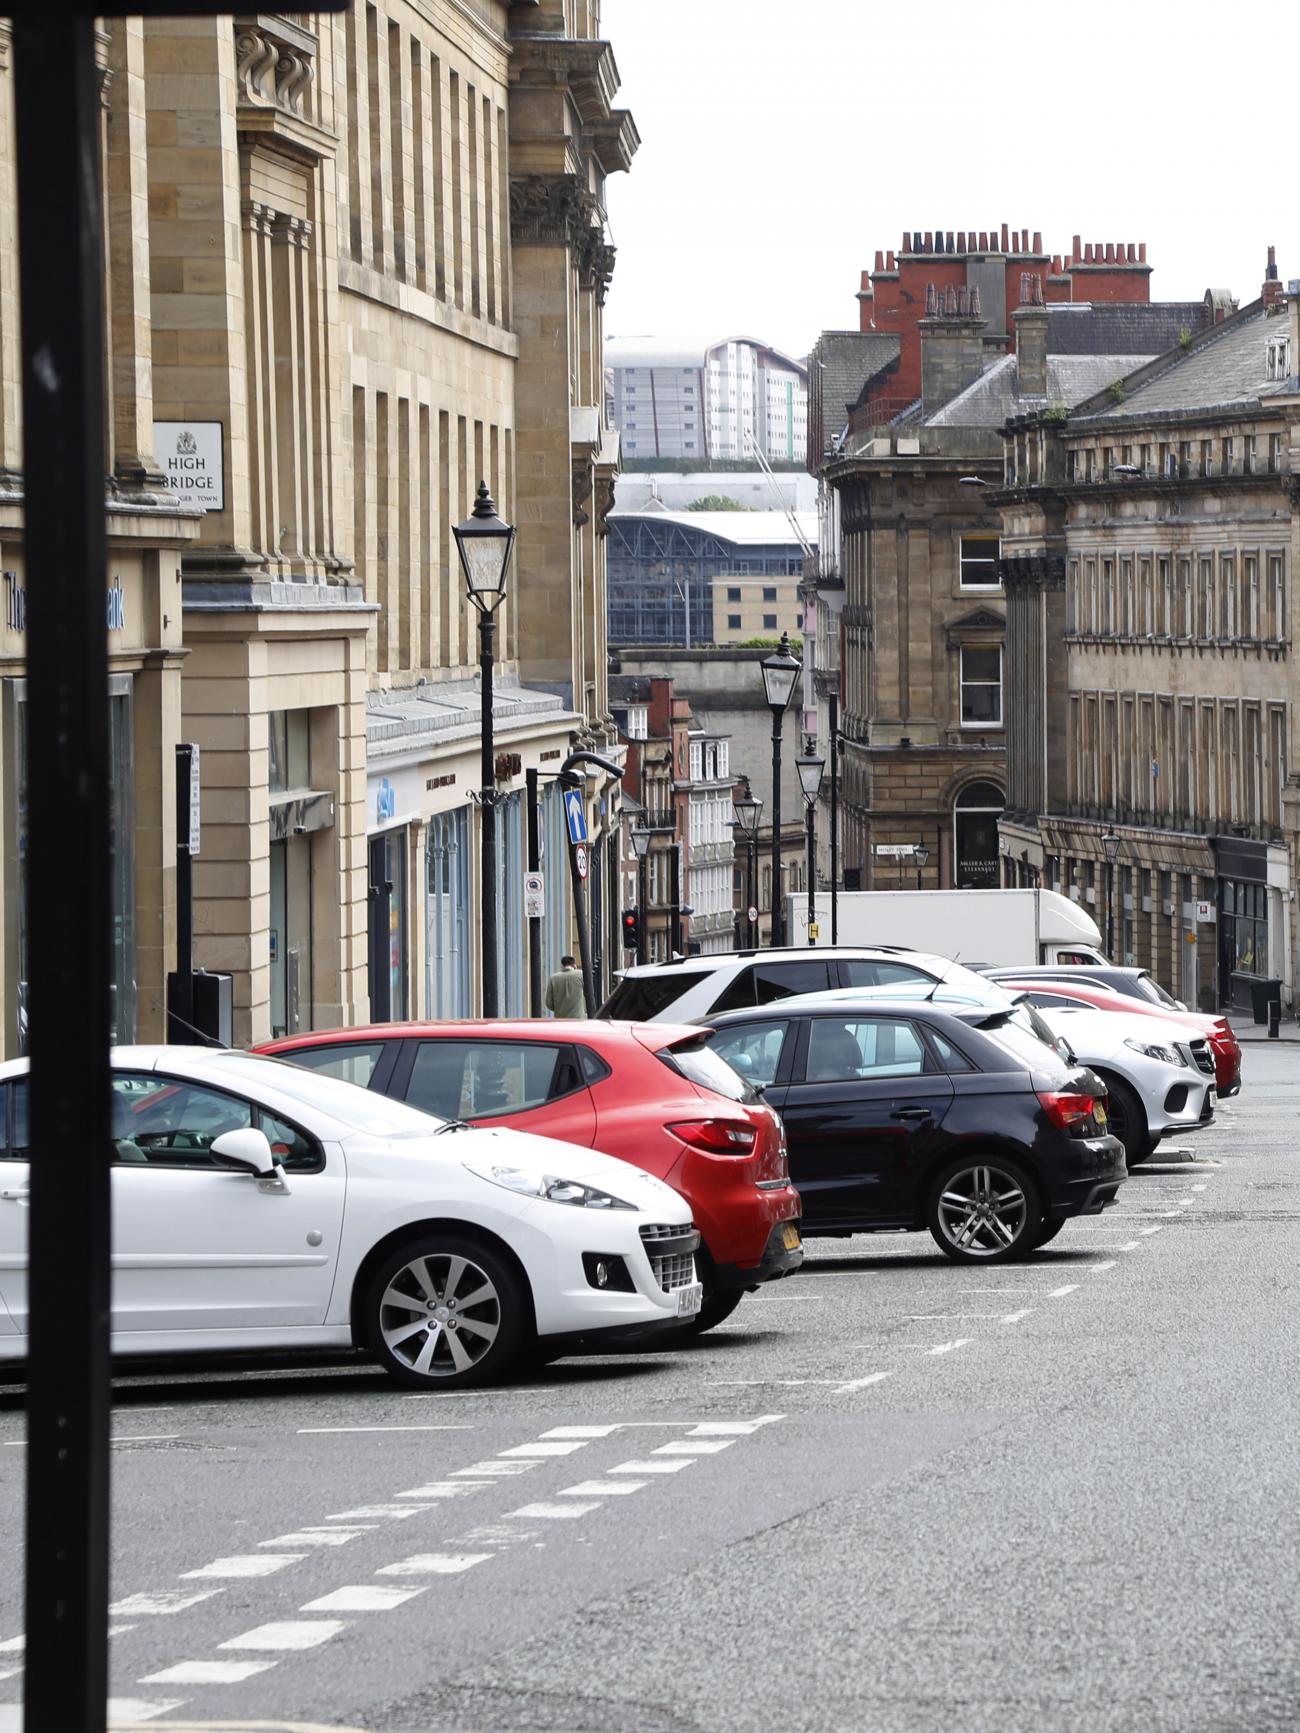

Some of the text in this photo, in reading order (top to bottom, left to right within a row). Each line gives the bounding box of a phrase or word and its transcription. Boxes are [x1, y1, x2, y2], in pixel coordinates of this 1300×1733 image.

[168, 457, 205, 470] HIGH
[161, 476, 213, 489] BRIDGE
[107, 576, 125, 631] ank
[810, 925, 818, 937] H
